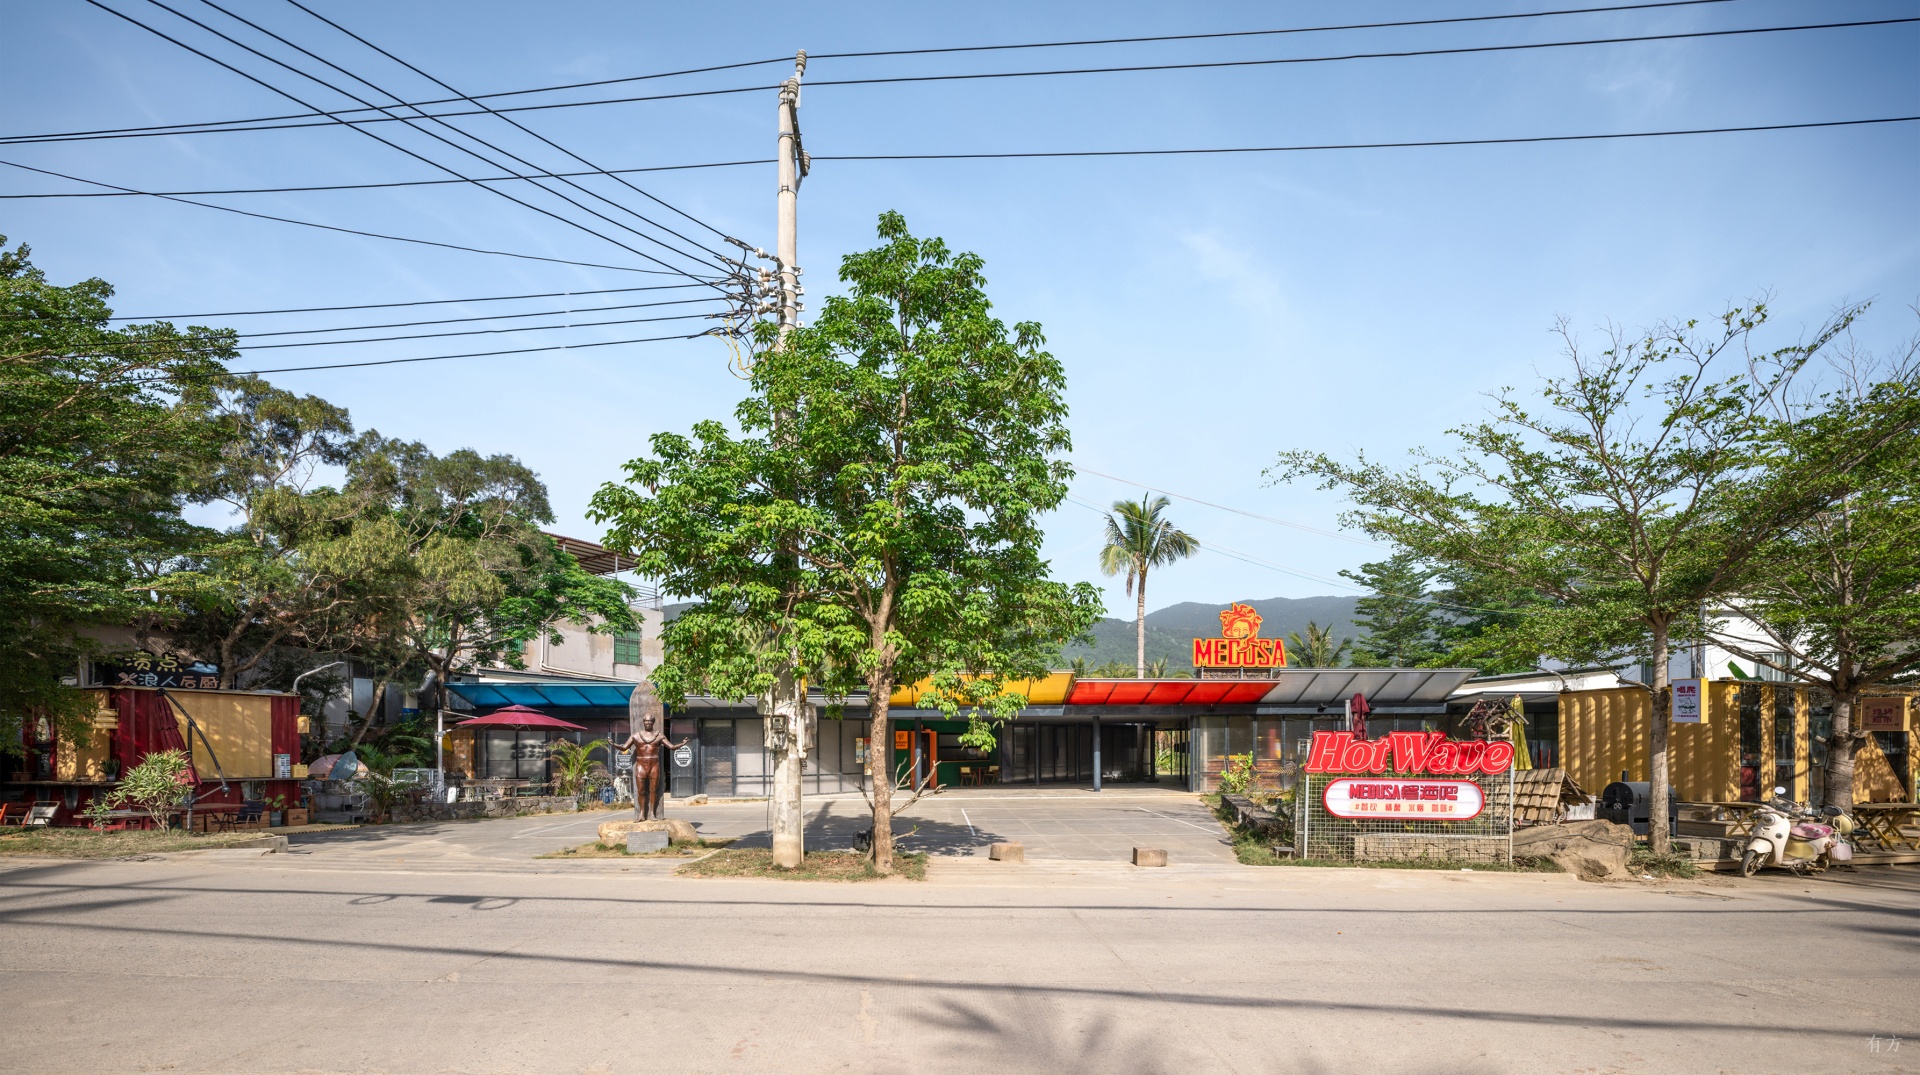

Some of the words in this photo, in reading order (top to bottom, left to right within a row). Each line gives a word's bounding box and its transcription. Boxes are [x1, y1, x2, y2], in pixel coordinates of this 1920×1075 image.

[1193, 638, 1287, 667] MEDUSA
[138, 672, 219, 689] 浪人后厨
